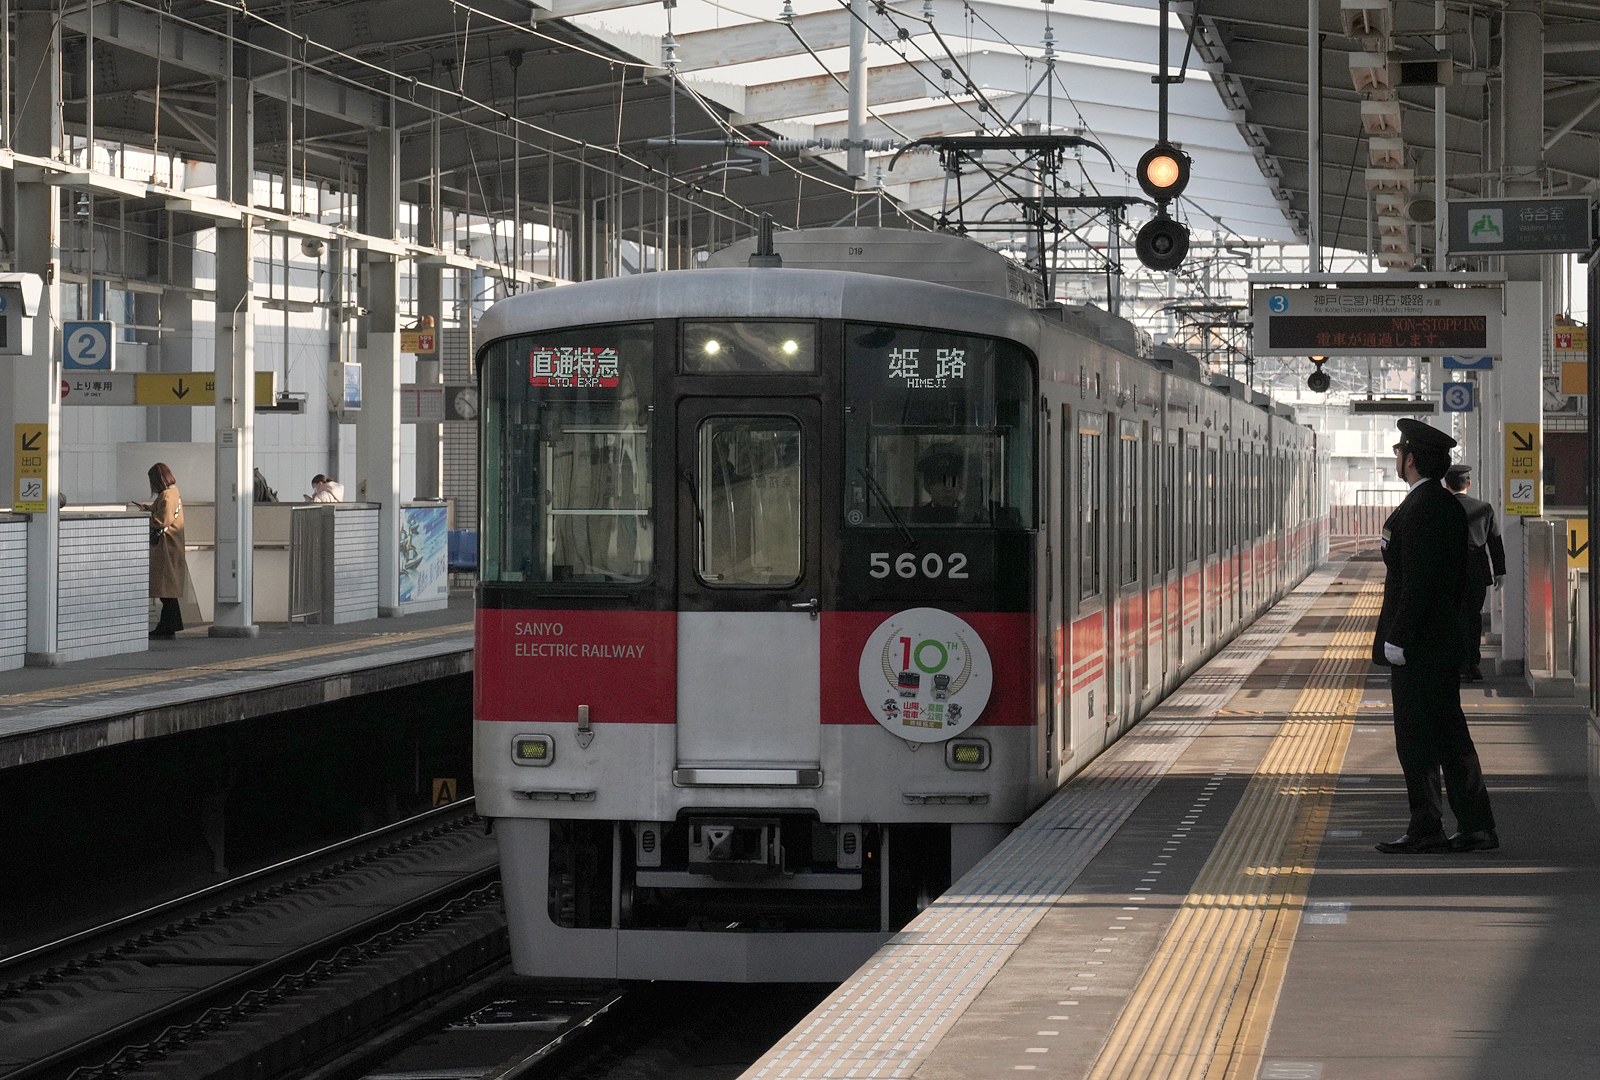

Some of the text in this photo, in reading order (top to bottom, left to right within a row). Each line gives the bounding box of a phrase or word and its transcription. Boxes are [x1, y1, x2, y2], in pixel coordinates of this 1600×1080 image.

[1519, 206, 1564, 221] 待合室
[848, 247, 863, 255] D19
[1274, 295, 1284, 312] 3
[1392, 318, 1485, 331] NON-STOPPING
[77, 333, 96, 359] 2
[1316, 332, 1445, 347] 電車が通過します。
[532, 347, 619, 378] 直通特急
[73, 381, 113, 391] 上り専用
[547, 377, 602, 387] LTD. EXP.
[907, 378, 946, 388] HIMEJI
[1451, 389, 1465, 406] 3
[21, 456, 42, 467] 出口
[1512, 457, 1533, 467] 出口
[869, 552, 969, 579] 5602
[515, 622, 563, 636] SANYO
[515, 643, 645, 658] ELECTRIC RAILWAY
[900, 636, 958, 674] 10 TH
[903, 710, 919, 719] 電車
[927, 712, 943, 721] 公司
[435, 780, 453, 806] A
